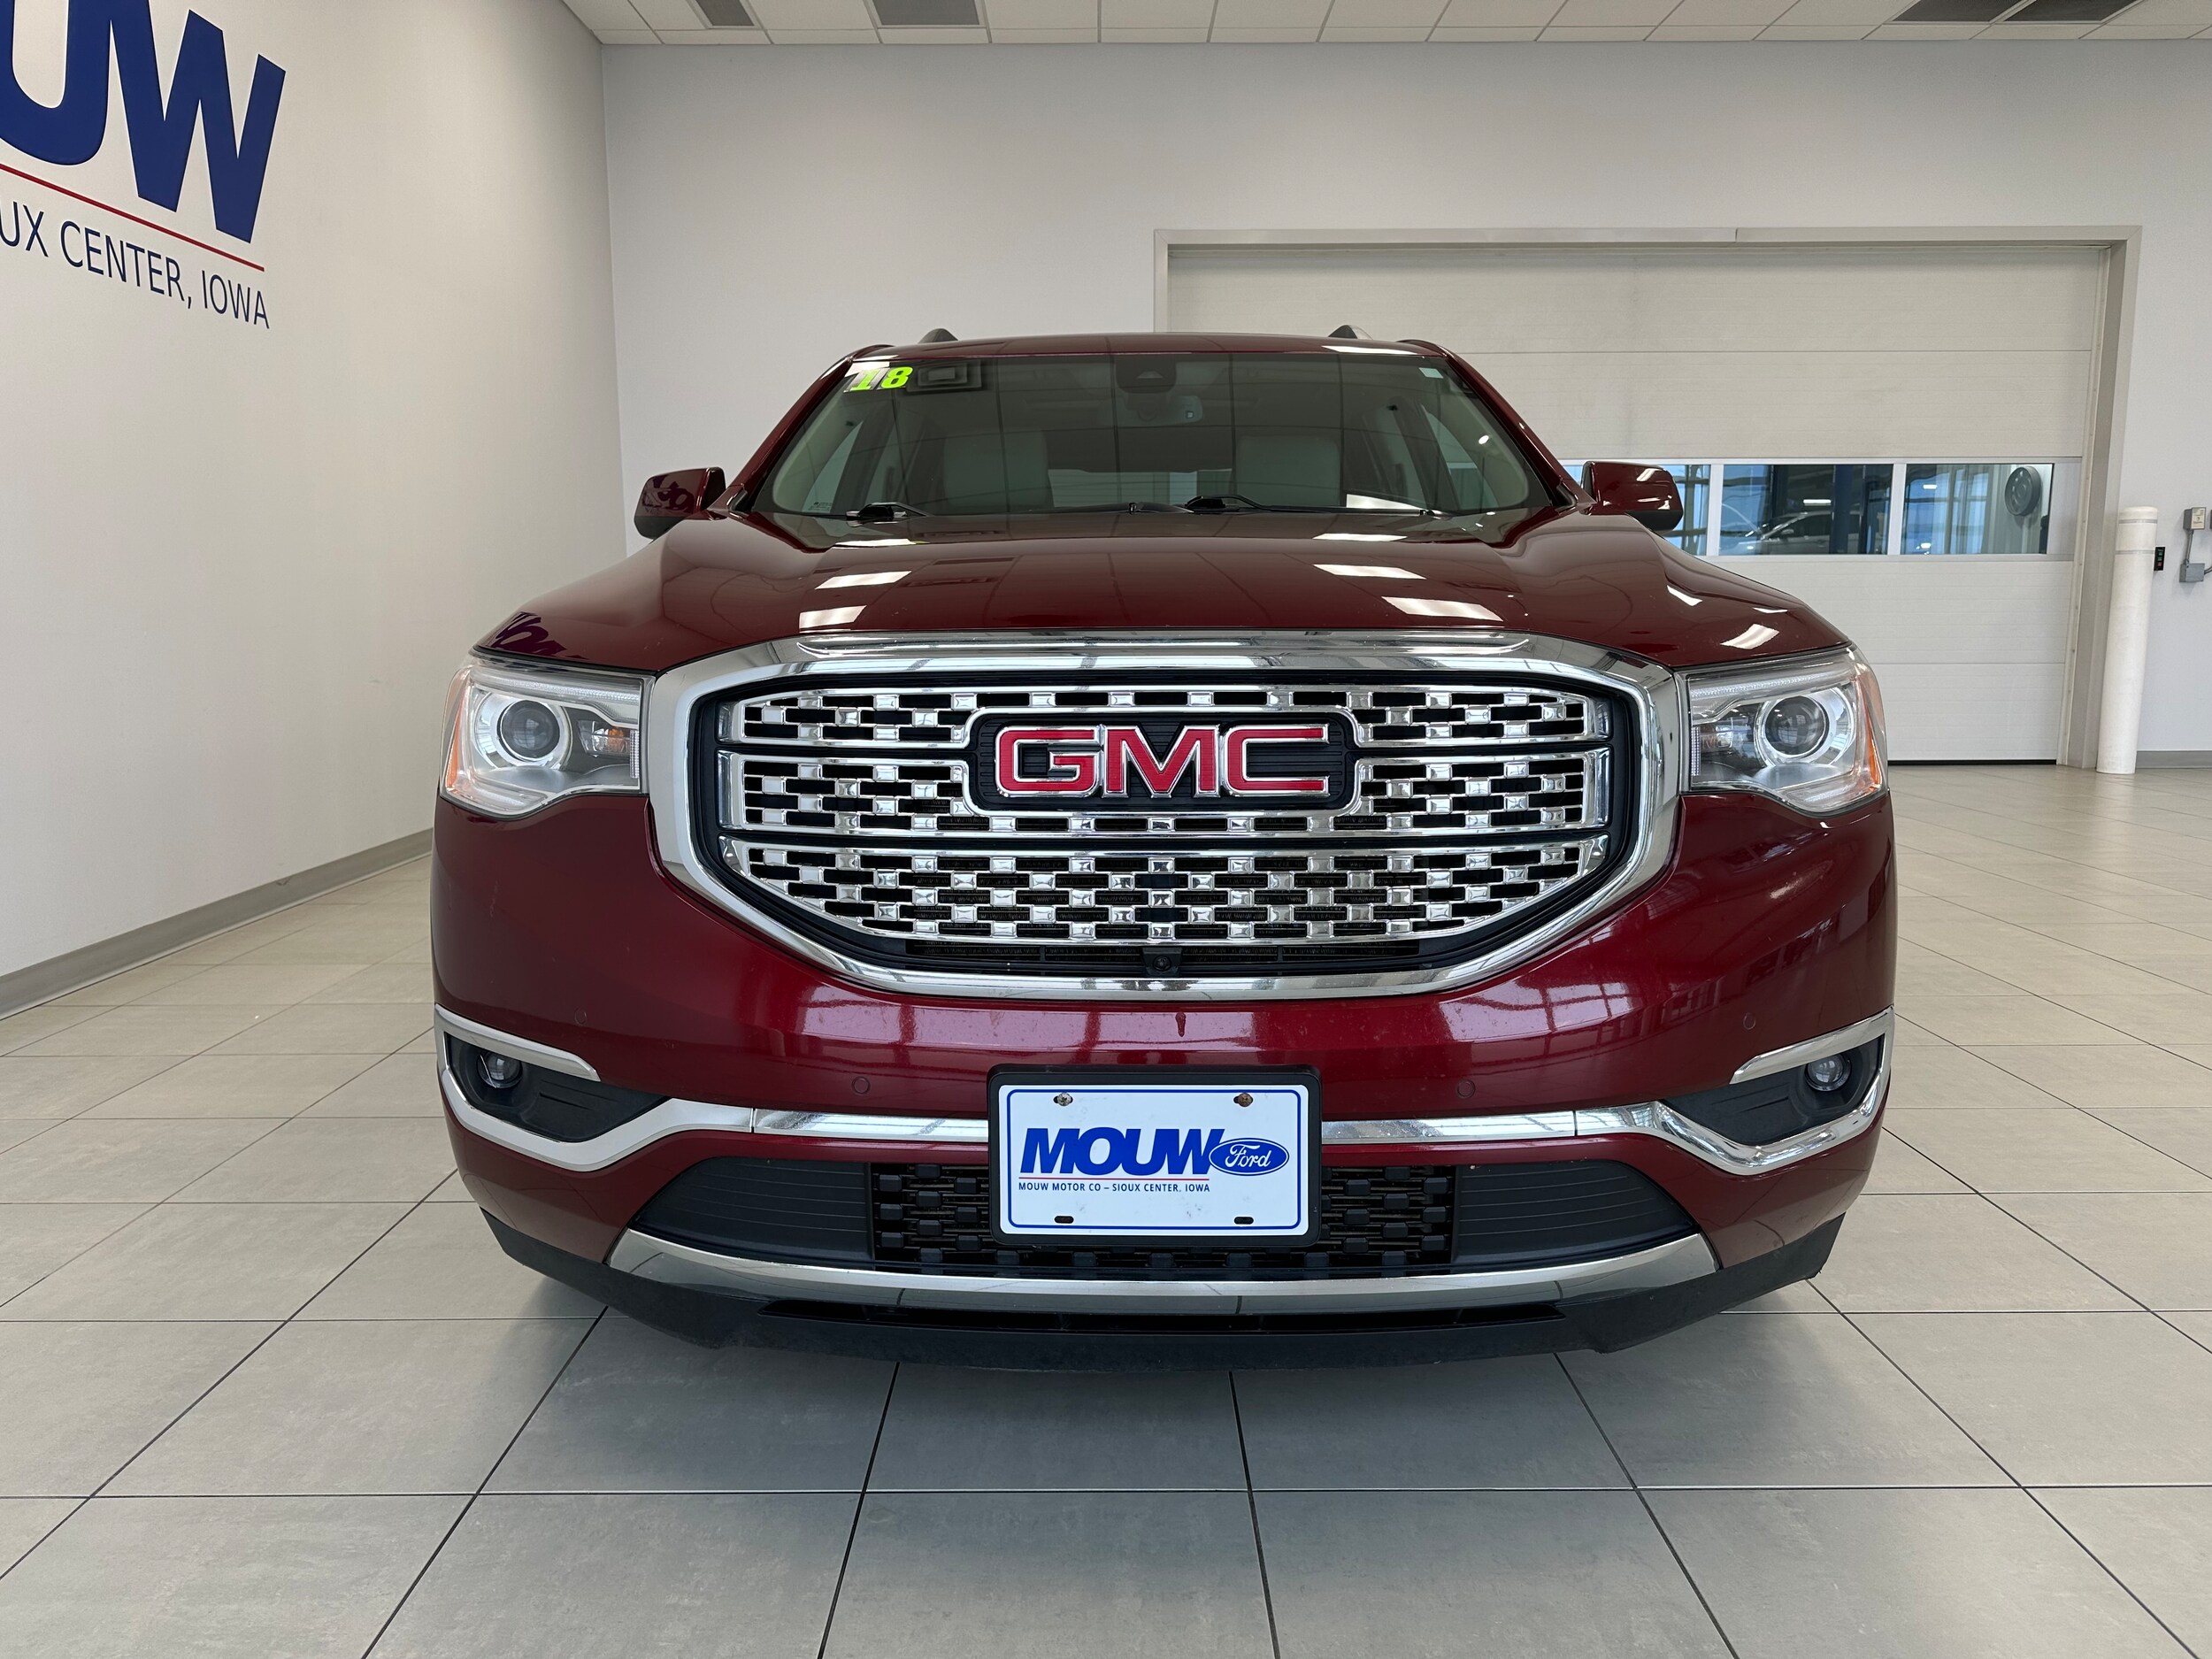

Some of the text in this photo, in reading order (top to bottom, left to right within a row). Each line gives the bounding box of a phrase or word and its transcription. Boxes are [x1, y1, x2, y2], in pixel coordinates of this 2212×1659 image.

[60, 220, 192, 310] CENTER,
[202, 270, 270, 329] IOWA
[848, 365, 914, 392] 18
[995, 724, 1330, 798] GMC
[1020, 1126, 1271, 1176] MOUW Ford
[1018, 1182, 1048, 1191] MOUW
[1052, 1182, 1086, 1192] MOTOR
[1088, 1182, 1101, 1192] CO
[1112, 1182, 1141, 1192] SIOUX
[1185, 1183, 1210, 1192] IOWA
